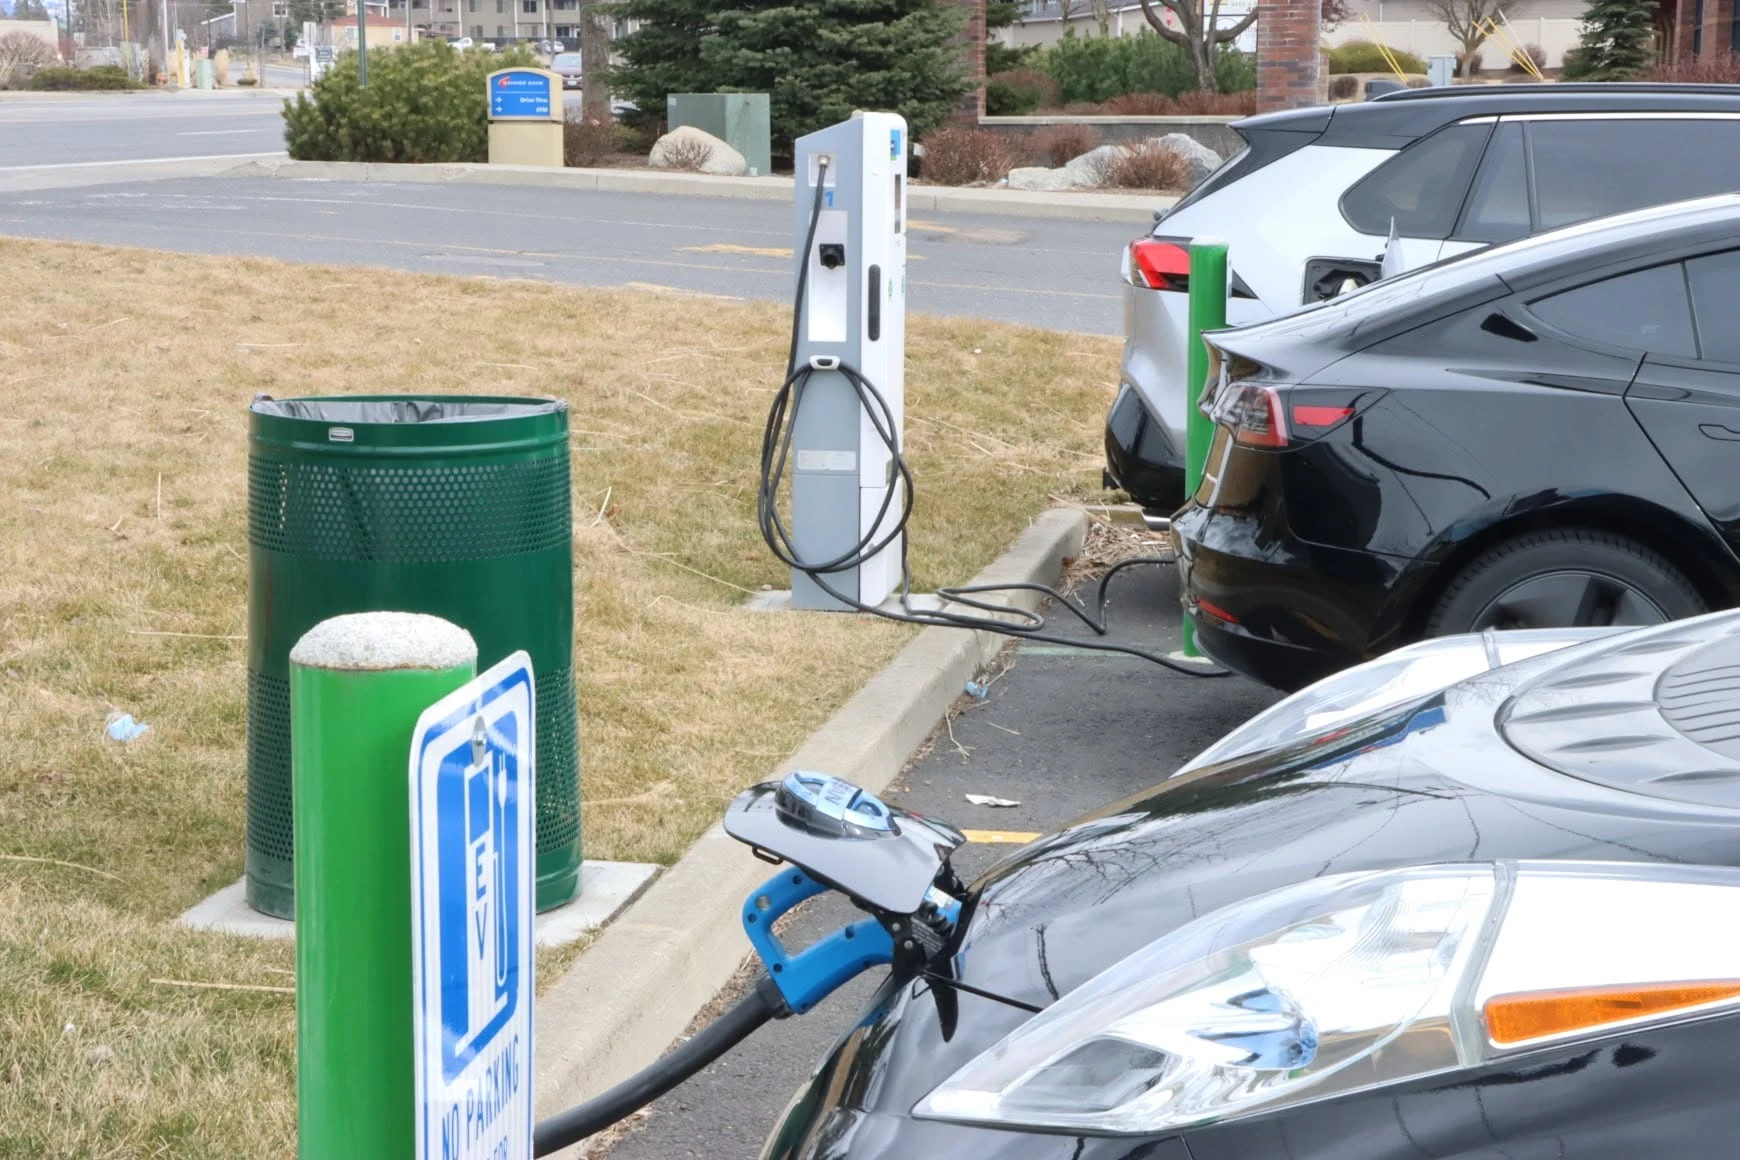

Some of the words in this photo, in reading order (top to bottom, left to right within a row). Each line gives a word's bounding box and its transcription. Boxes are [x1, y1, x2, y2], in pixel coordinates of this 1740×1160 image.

[824, 191, 834, 207] 1
[442, 1102, 459, 1160] NO
[466, 1033, 519, 1151] PARKING
